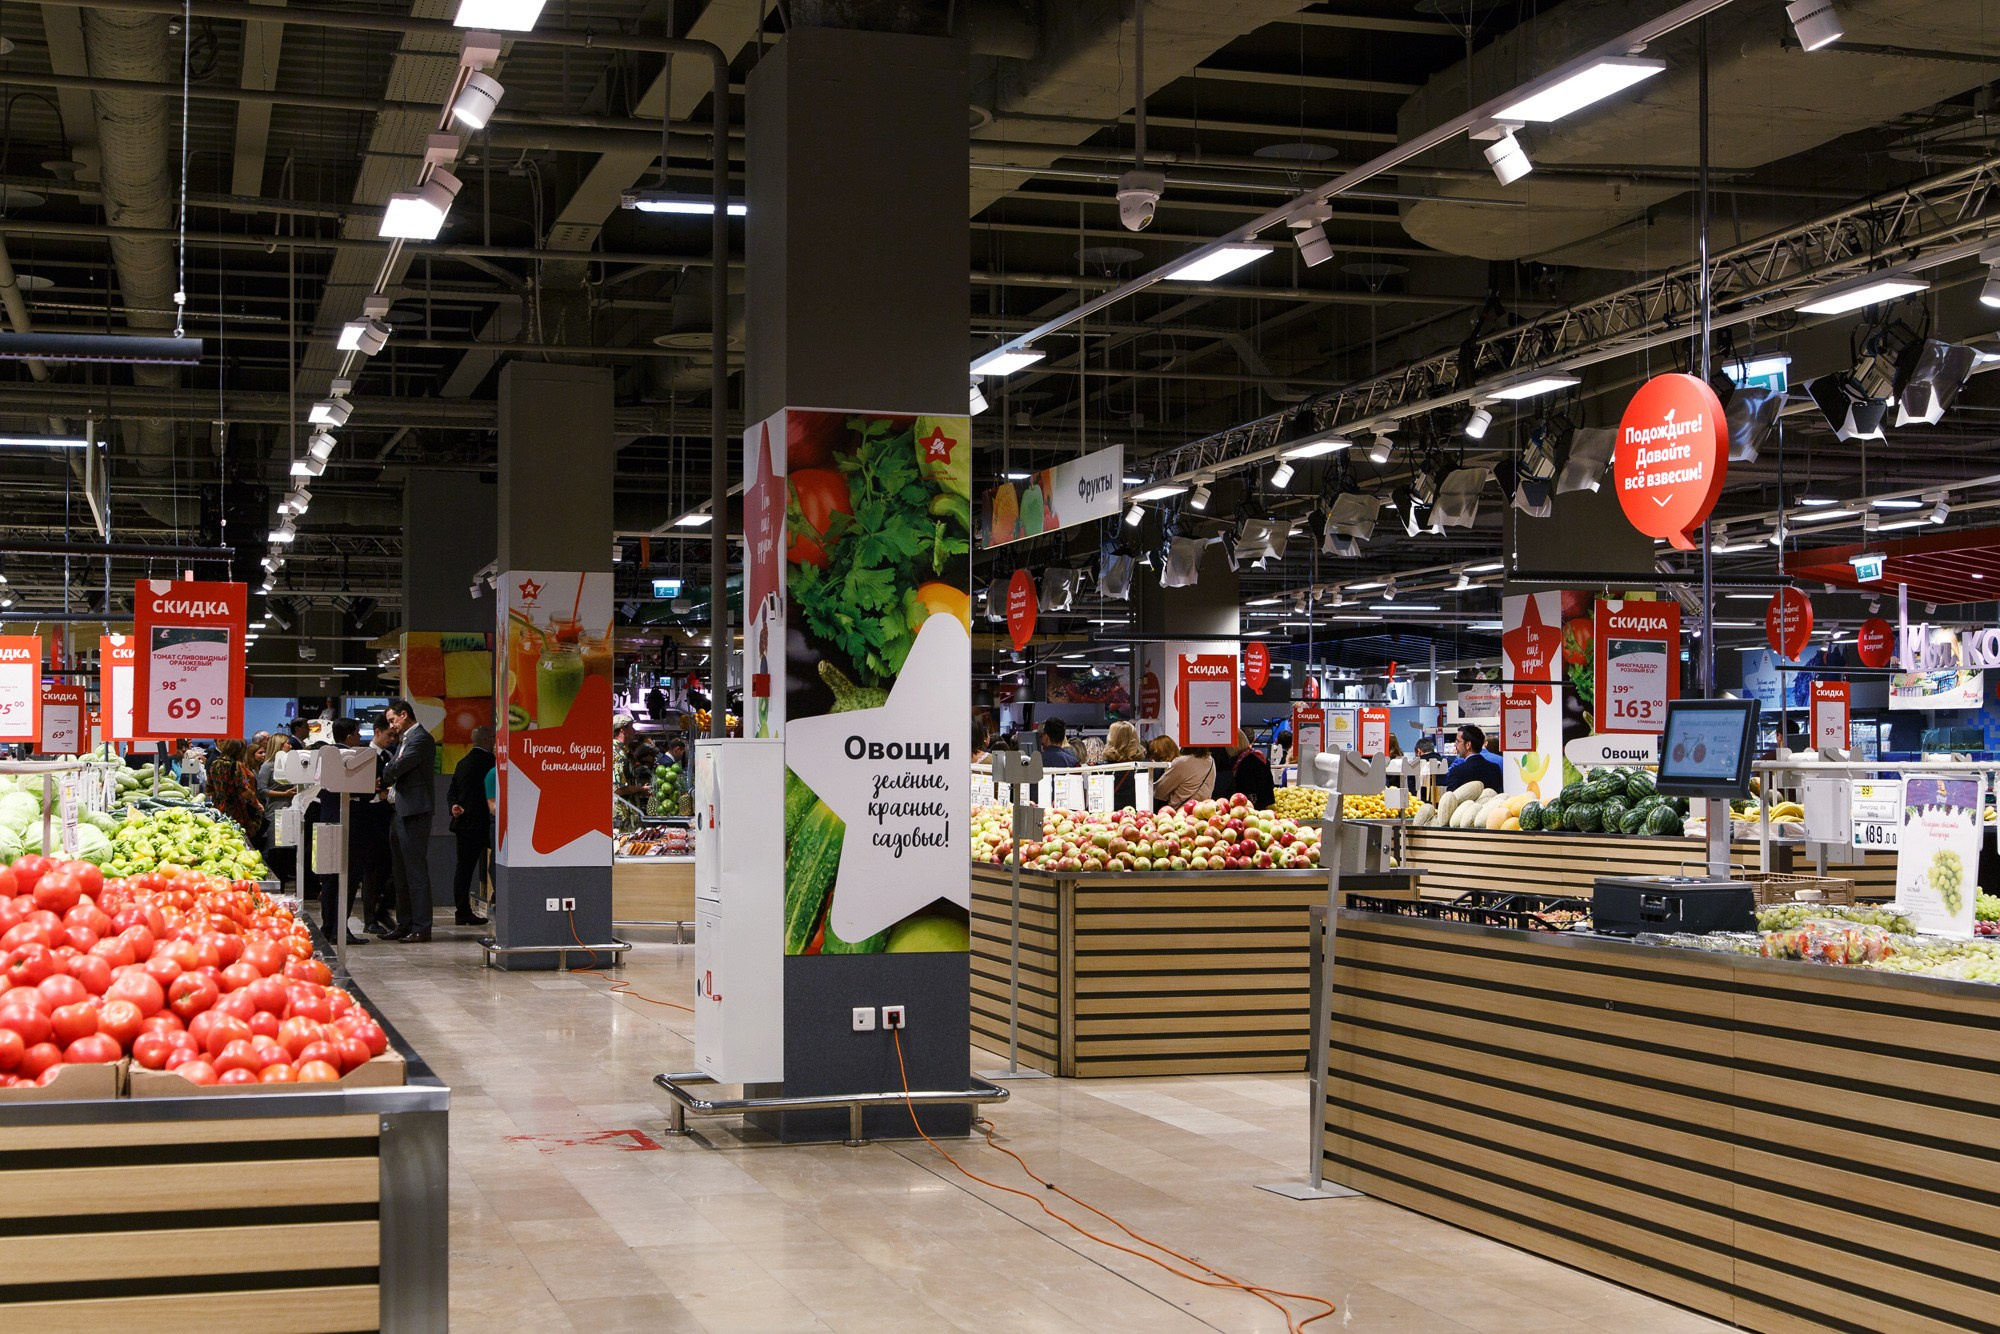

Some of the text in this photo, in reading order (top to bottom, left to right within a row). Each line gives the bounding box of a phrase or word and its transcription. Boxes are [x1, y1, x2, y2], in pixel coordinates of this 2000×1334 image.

[1625, 413, 1703, 445] Подождите!
[1635, 442, 1691, 470] Давайте
[1624, 461, 1703, 490] всё взвесим!
[1078, 473, 1113, 503] Фрукты
[152, 599, 230, 618] СКИДКА
[1608, 616, 1668, 632] СКИДКА
[169, 659, 213, 667] ОРАНЖЕВЫЙ
[177, 654, 228, 663] СЛИВОВИДНЫЙ
[1187, 665, 1230, 677] СКИДКА
[162, 681, 177, 690] 98
[1612, 685, 1629, 694] 199
[1816, 689, 1845, 698] СКИДКА
[14, 700, 25, 708] 00
[42, 693, 78, 702] СКИДКА
[1505, 699, 1532, 707] СКИДКА
[167, 697, 224, 719] 69 00
[1613, 699, 1652, 719] 163
[1200, 715, 1216, 726] 57
[52, 731, 64, 740] 69
[1825, 727, 1835, 736] 59
[523, 738, 566, 758] Просто,
[569, 742, 606, 759] вкусно,
[844, 735, 950, 765] Овощи
[1601, 746, 1649, 761] Овощи
[541, 756, 606, 772] витаминно!
[872, 771, 949, 800] зелёные,
[868, 801, 949, 826] красные,
[872, 820, 950, 859] садовые!
